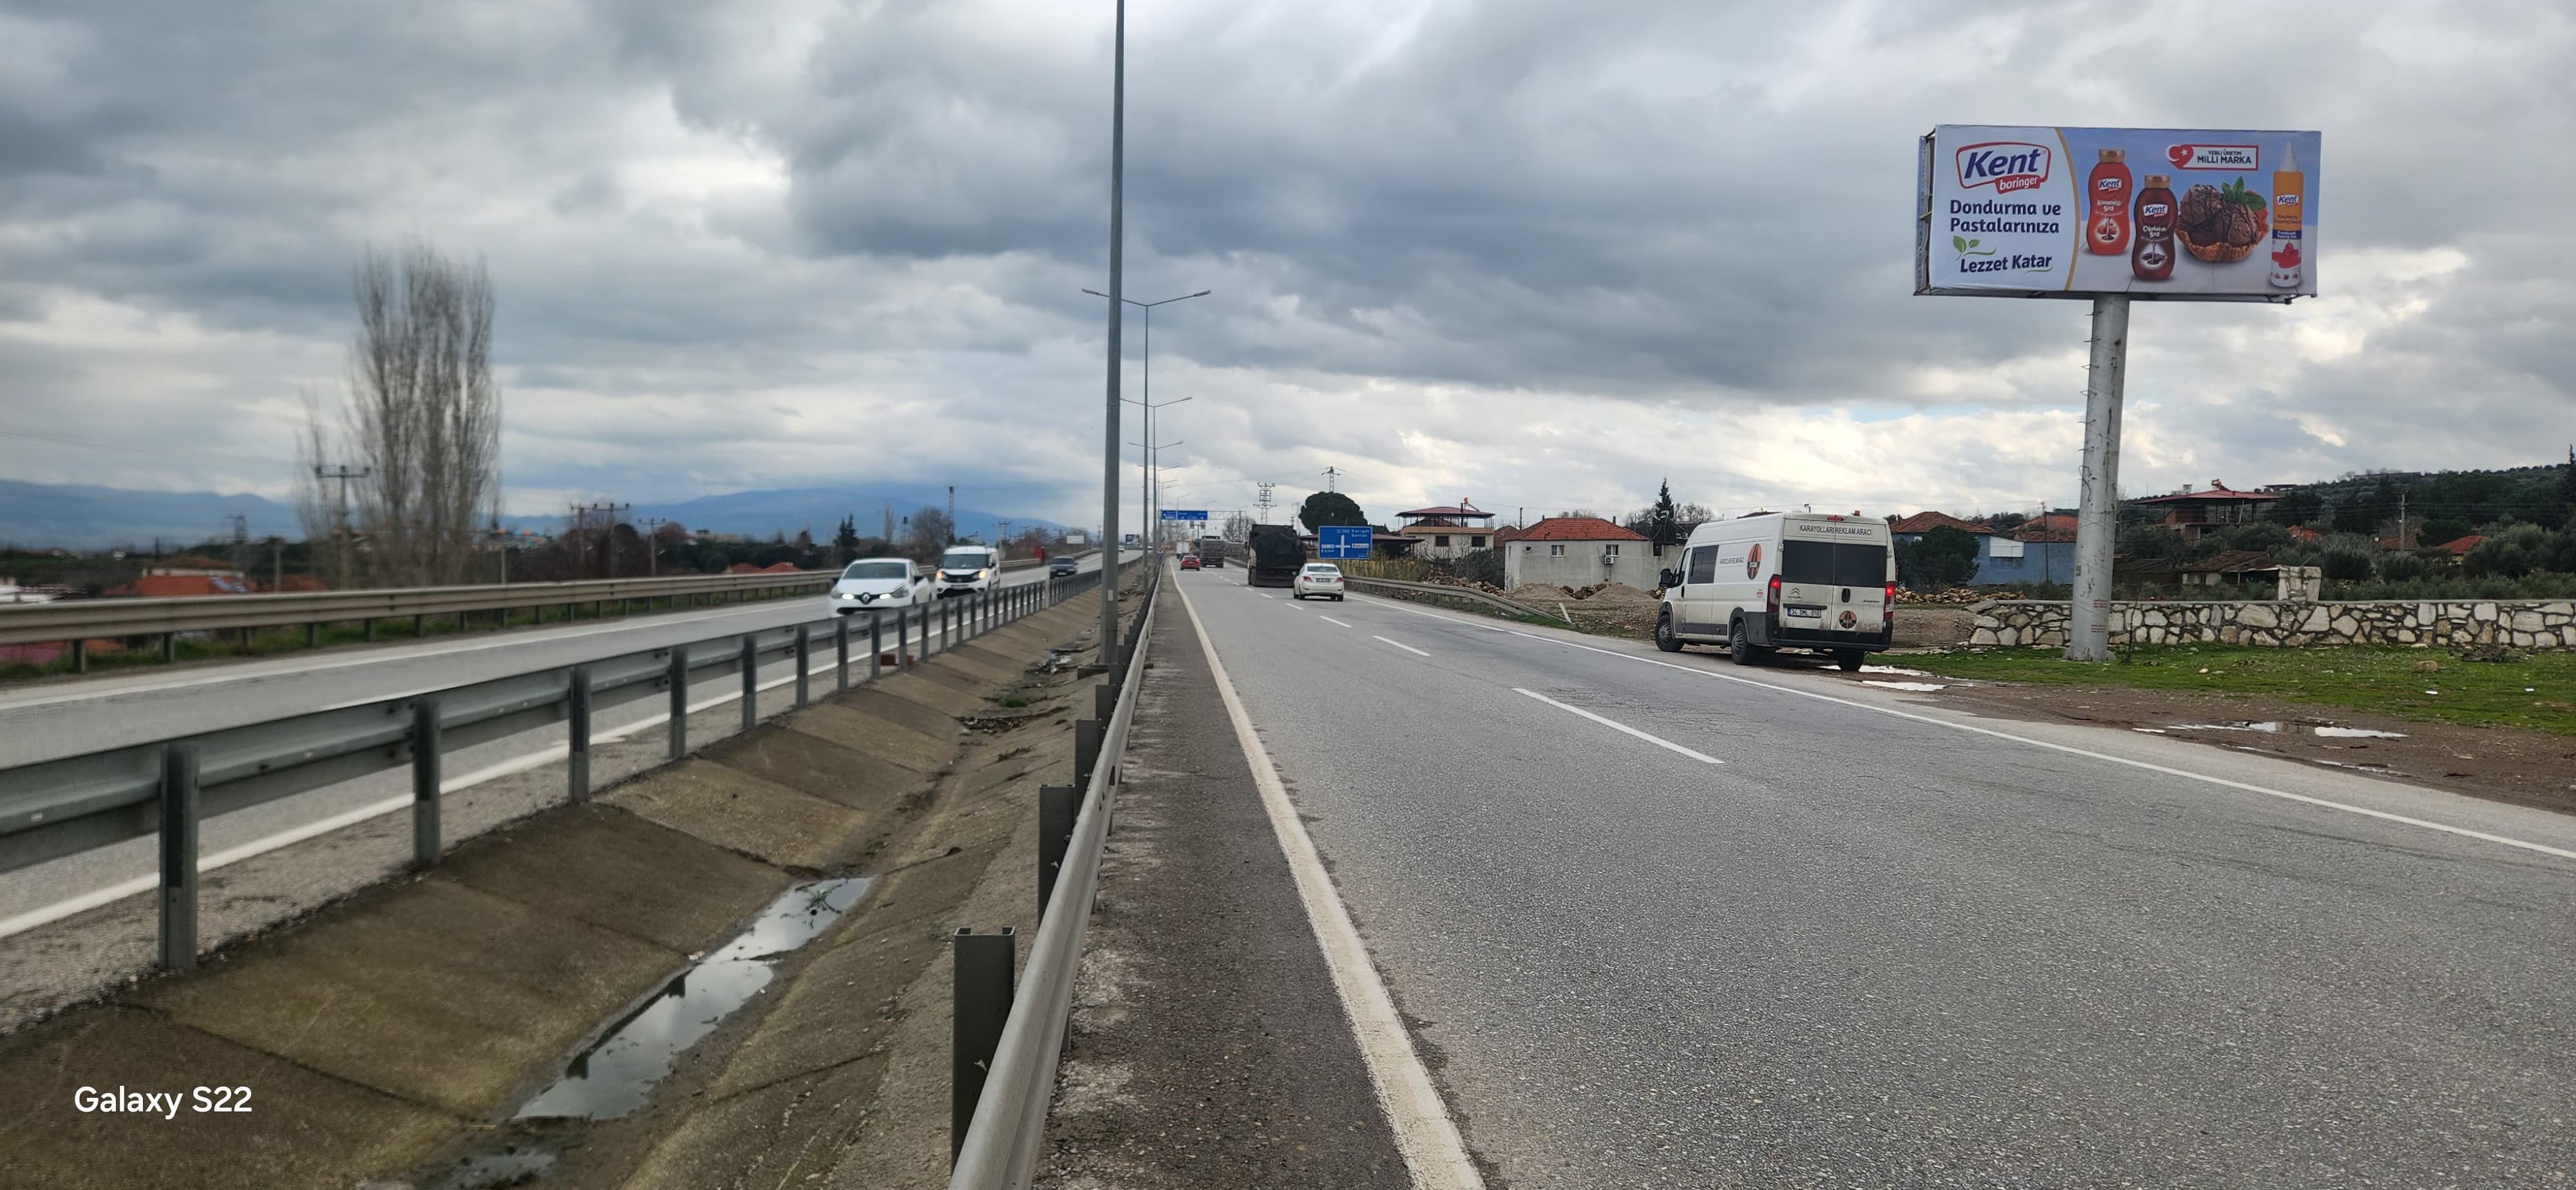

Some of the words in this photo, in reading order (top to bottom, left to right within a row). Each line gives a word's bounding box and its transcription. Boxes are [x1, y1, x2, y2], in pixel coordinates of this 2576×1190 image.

[1964, 149, 2041, 179] Kent
[2221, 156, 2252, 164] MARKA
[2000, 176, 2038, 191] boringer
[2099, 180, 2120, 188] Kent
[2278, 195, 2298, 203] Kent
[1950, 200, 2037, 215] Dondurma
[2042, 203, 2061, 216] ve
[2145, 205, 2166, 214] Kent
[1950, 218, 2060, 233] Pastalarınıza
[1960, 257, 2008, 273] Lezzet
[2011, 254, 2052, 270] Katar
[1800, 524, 1834, 534] KARAYOLLARI
